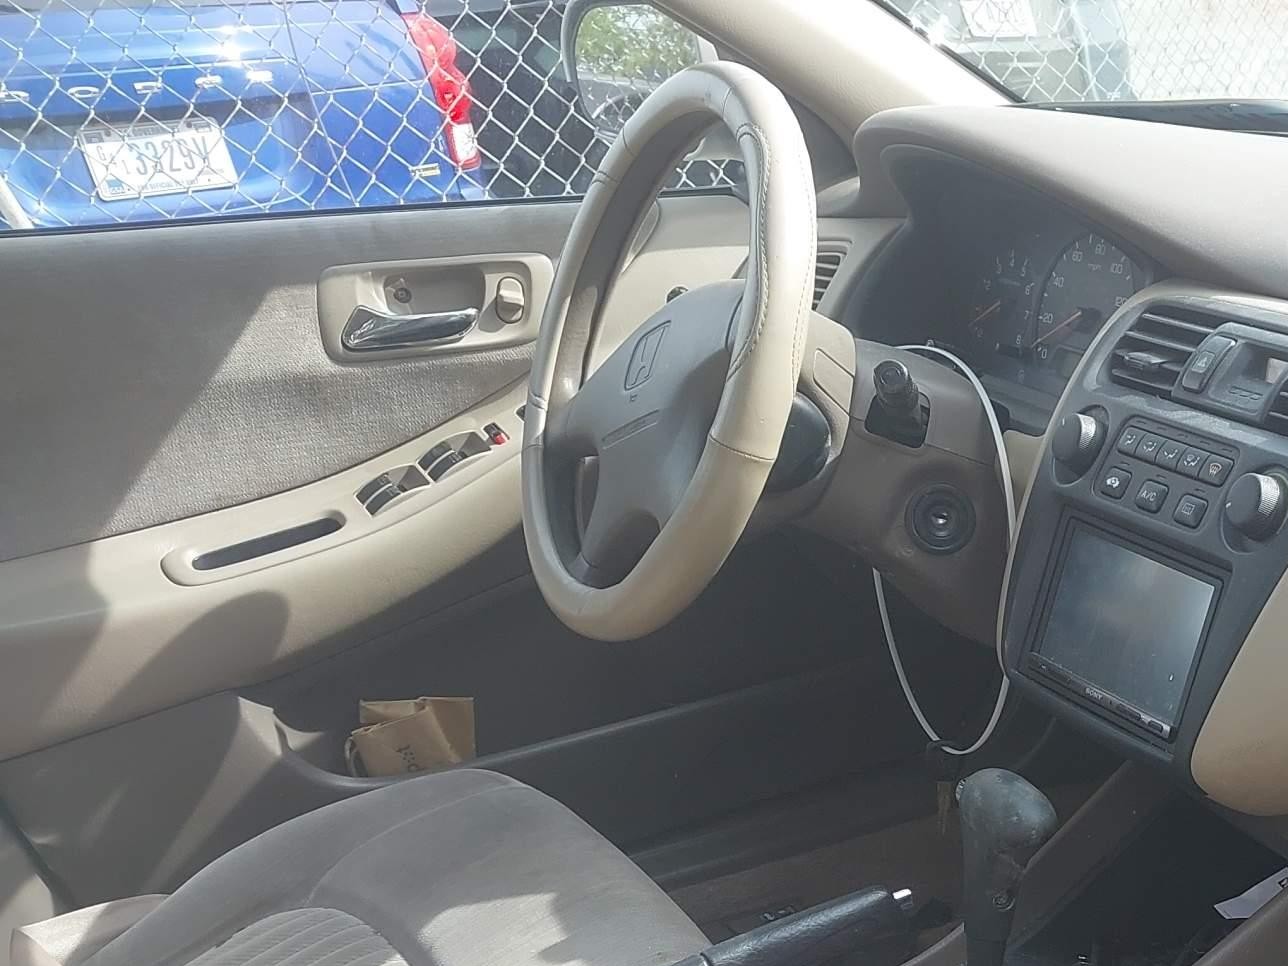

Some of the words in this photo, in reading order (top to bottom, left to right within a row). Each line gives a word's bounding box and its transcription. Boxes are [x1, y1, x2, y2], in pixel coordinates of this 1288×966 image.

[1042, 313, 1054, 323] 20
[1140, 489, 1157, 502] A/C
[1085, 687, 1104, 700] SONY
